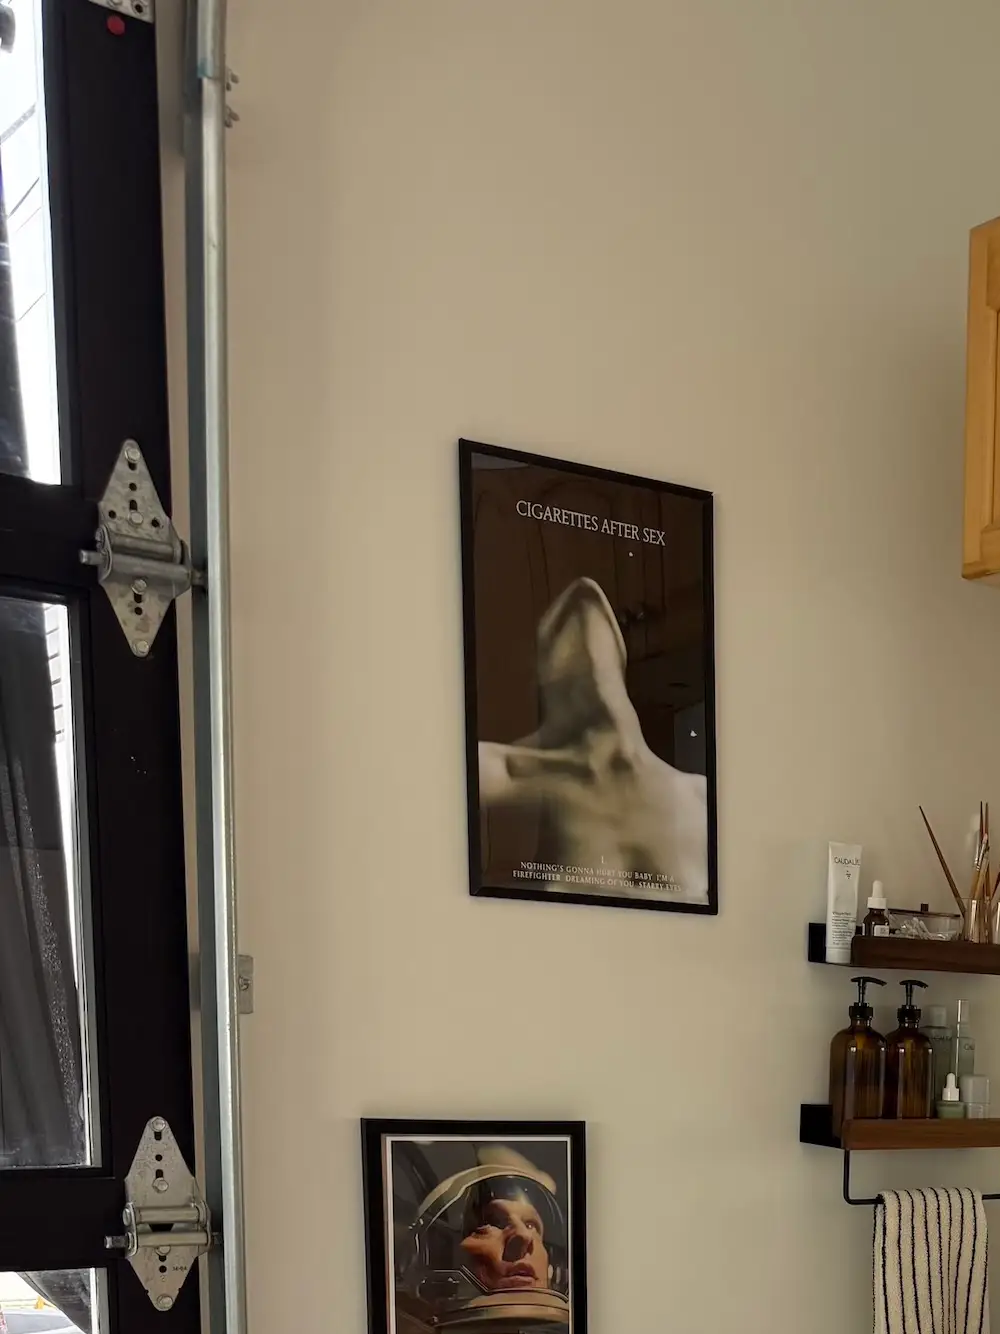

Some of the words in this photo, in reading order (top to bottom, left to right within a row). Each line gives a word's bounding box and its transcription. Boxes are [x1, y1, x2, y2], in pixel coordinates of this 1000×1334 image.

[515, 499, 599, 532] CIGARETTES
[600, 518, 641, 541] AFTER
[642, 527, 666, 546] SEX
[512, 869, 561, 881] FIREFIGHTER
[520, 861, 564, 873] NOTHING'S
[565, 865, 594, 875] GONNA
[634, 871, 653, 880] BABY
